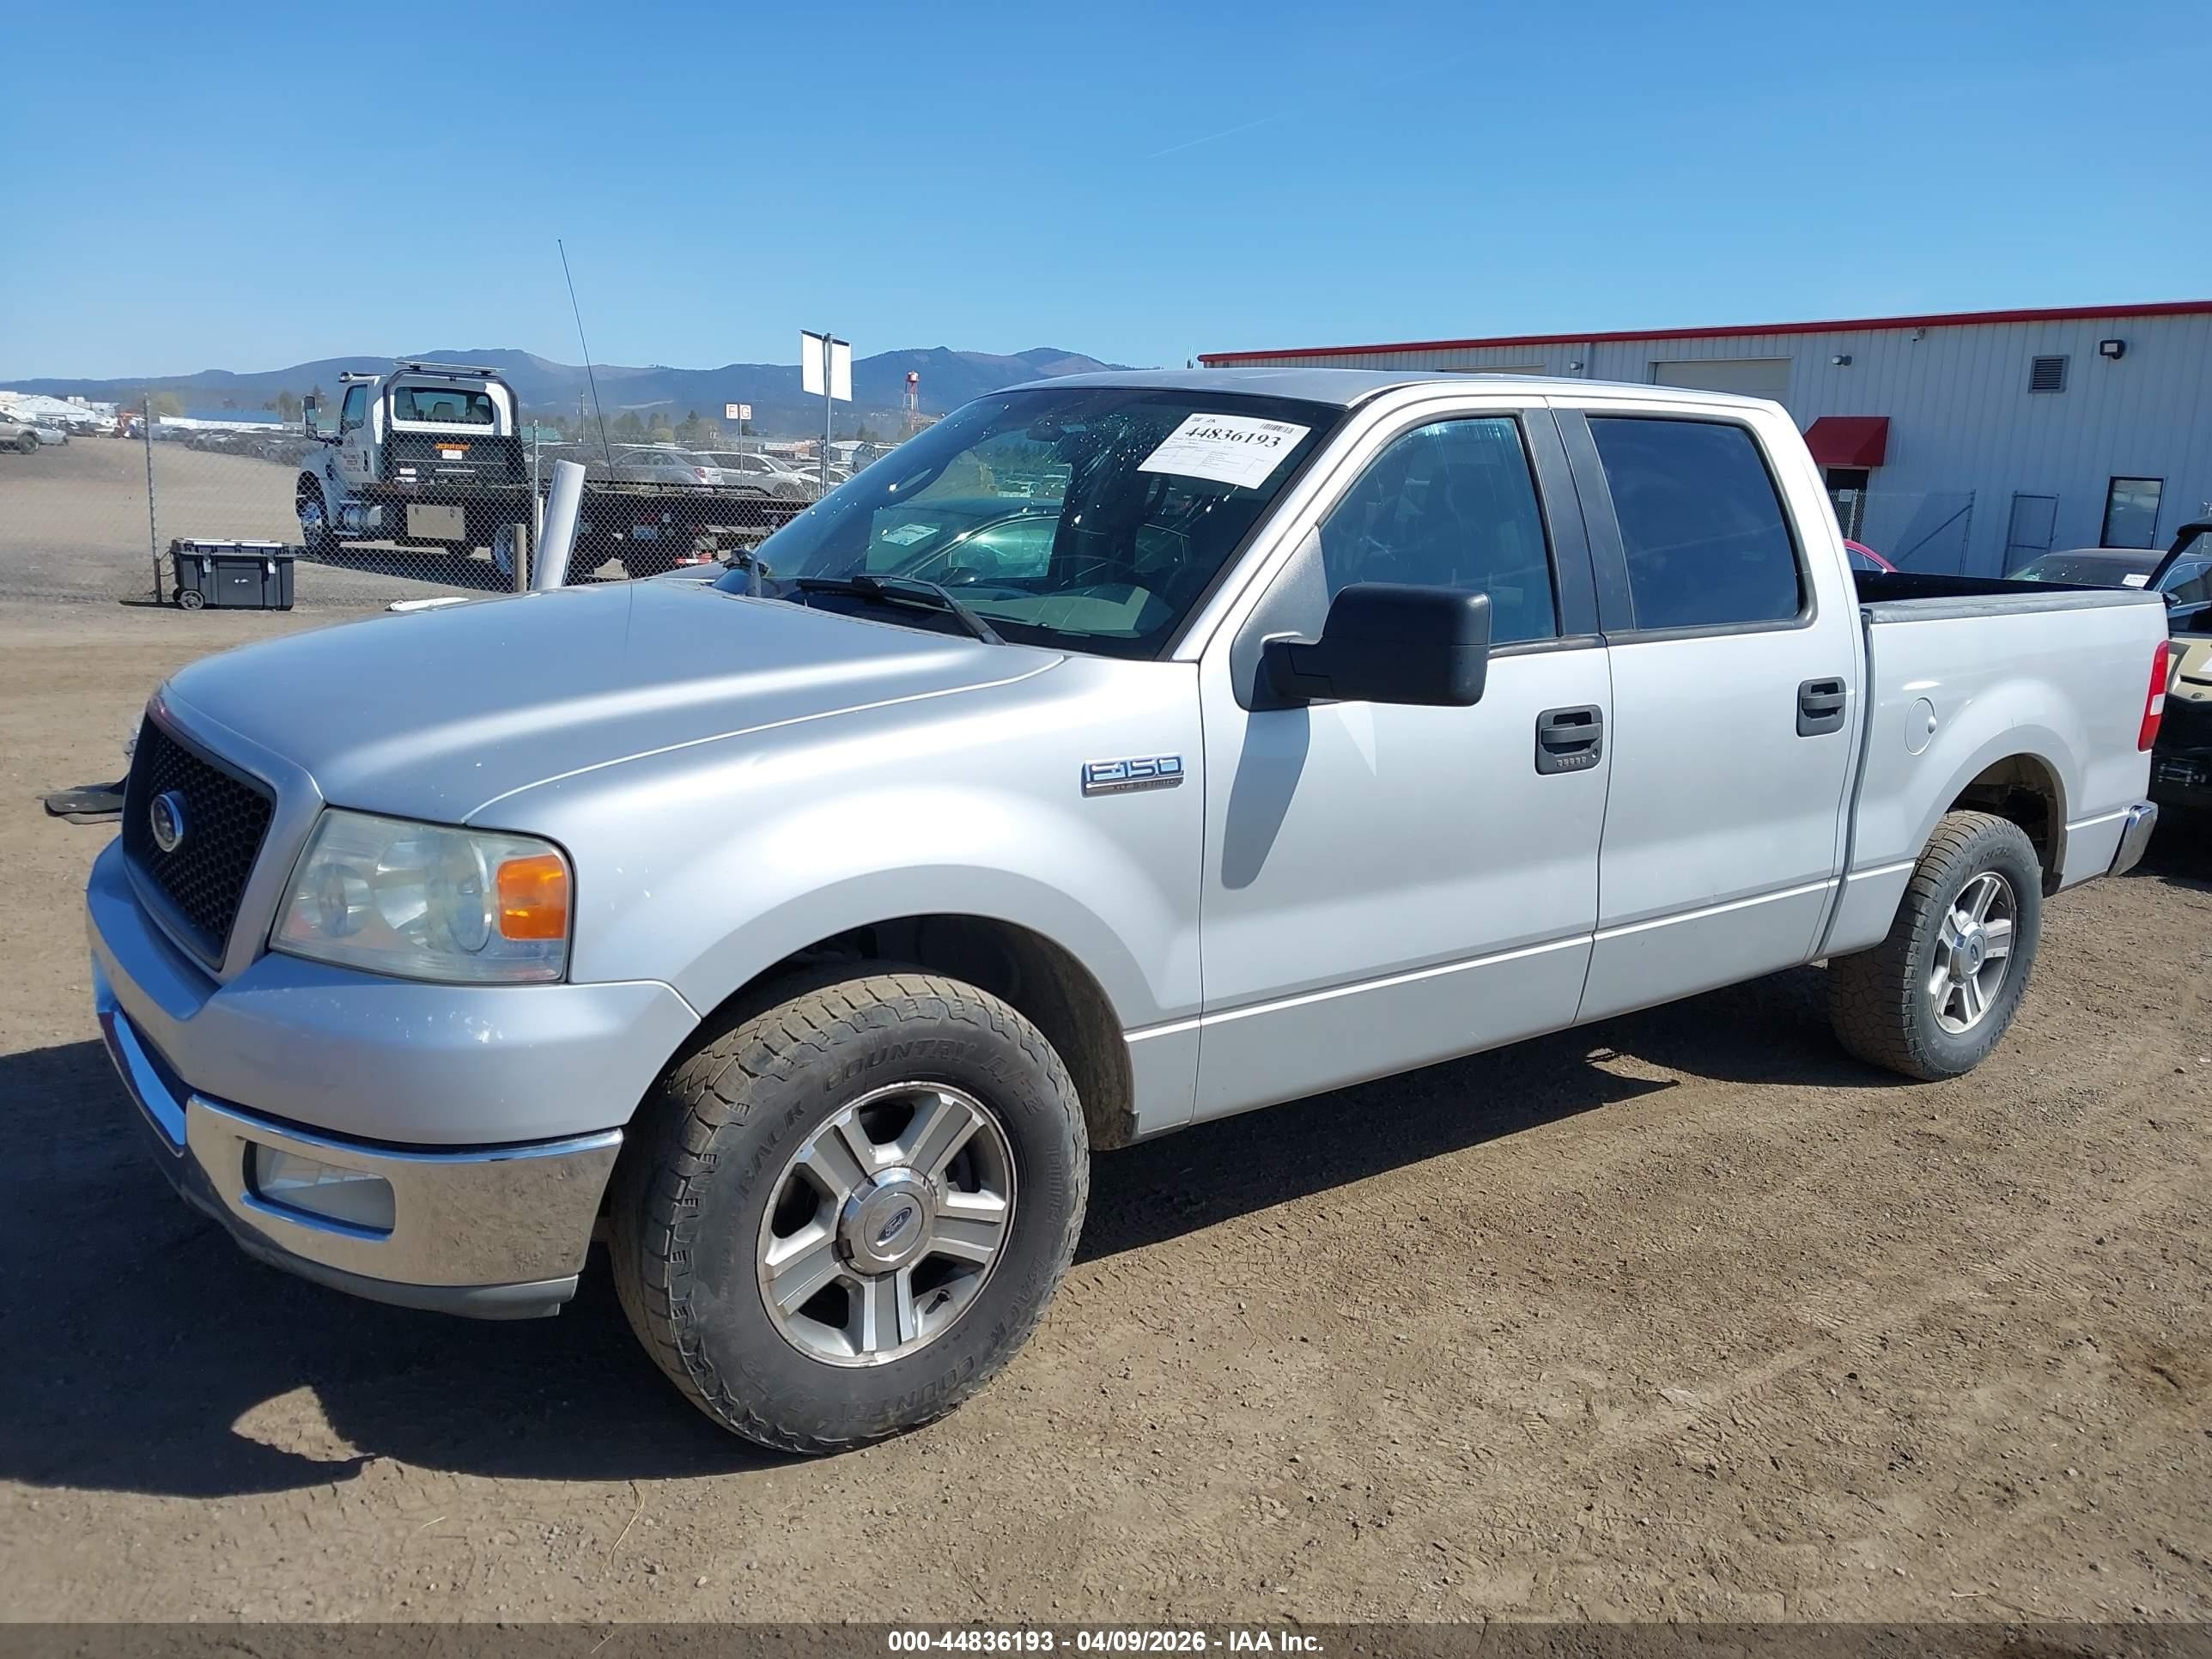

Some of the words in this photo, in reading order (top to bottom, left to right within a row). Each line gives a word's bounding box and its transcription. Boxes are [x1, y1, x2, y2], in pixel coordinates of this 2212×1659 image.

[741, 406, 750, 418] G
[1185, 427, 1281, 447] 44836193
[824, 1039, 976, 1094] COUNTRY
